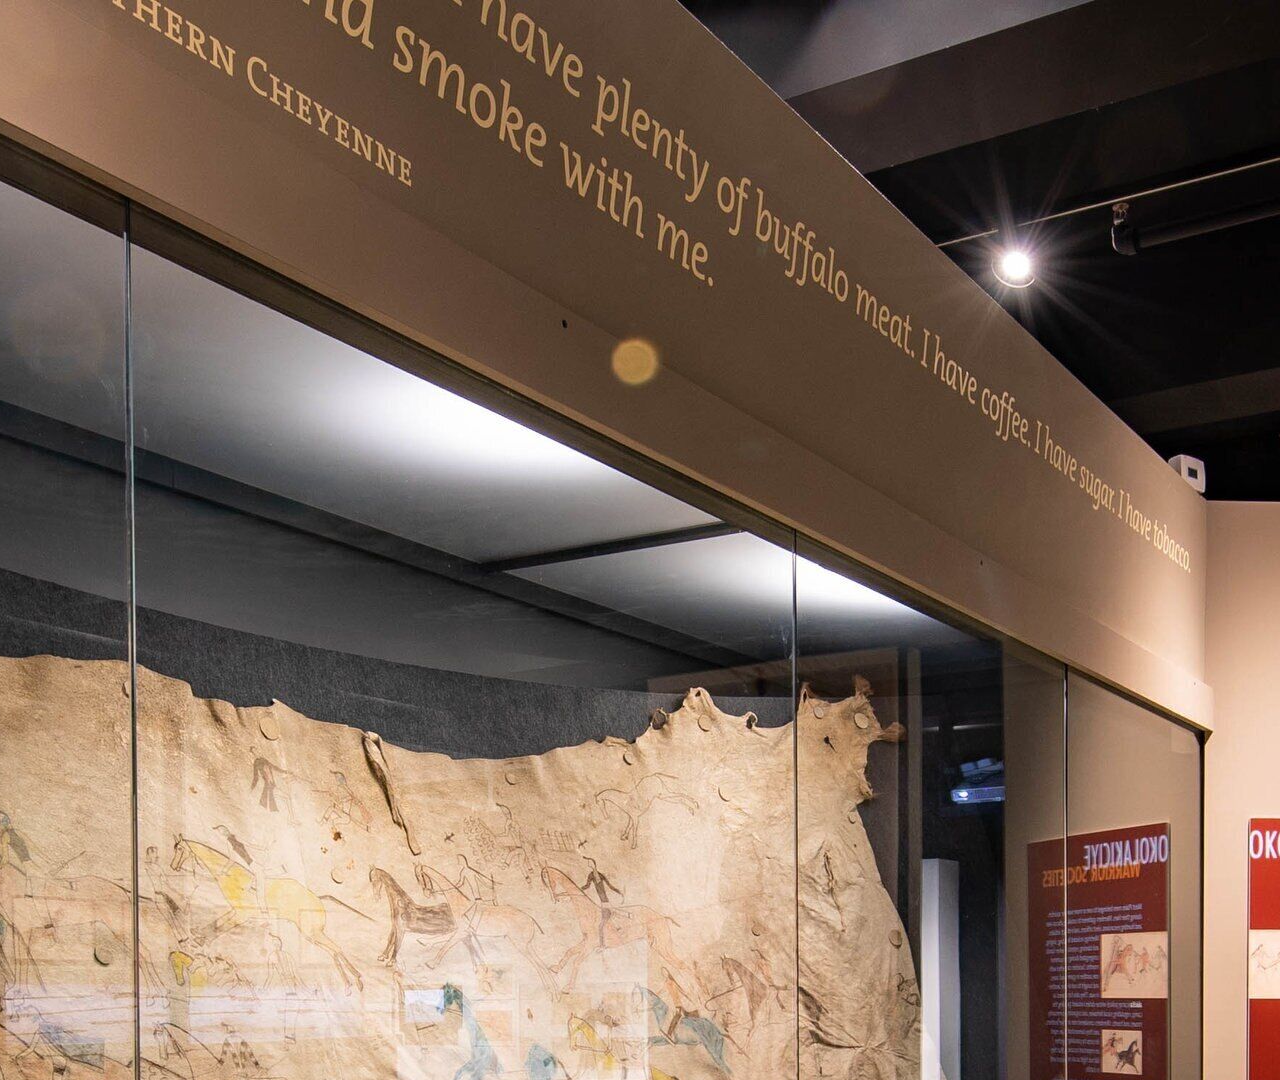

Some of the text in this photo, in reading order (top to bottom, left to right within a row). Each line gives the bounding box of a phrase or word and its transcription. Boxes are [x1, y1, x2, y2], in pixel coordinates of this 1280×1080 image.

[246, 56, 412, 187] CHEYENNE
[392, 25, 547, 168] smoke
[559, 141, 644, 239] with
[657, 212, 714, 287] me.
[480, 0, 1192, 573] have plenty of buffalo meat. I have coffee. I have sugar. I have tobacco.
